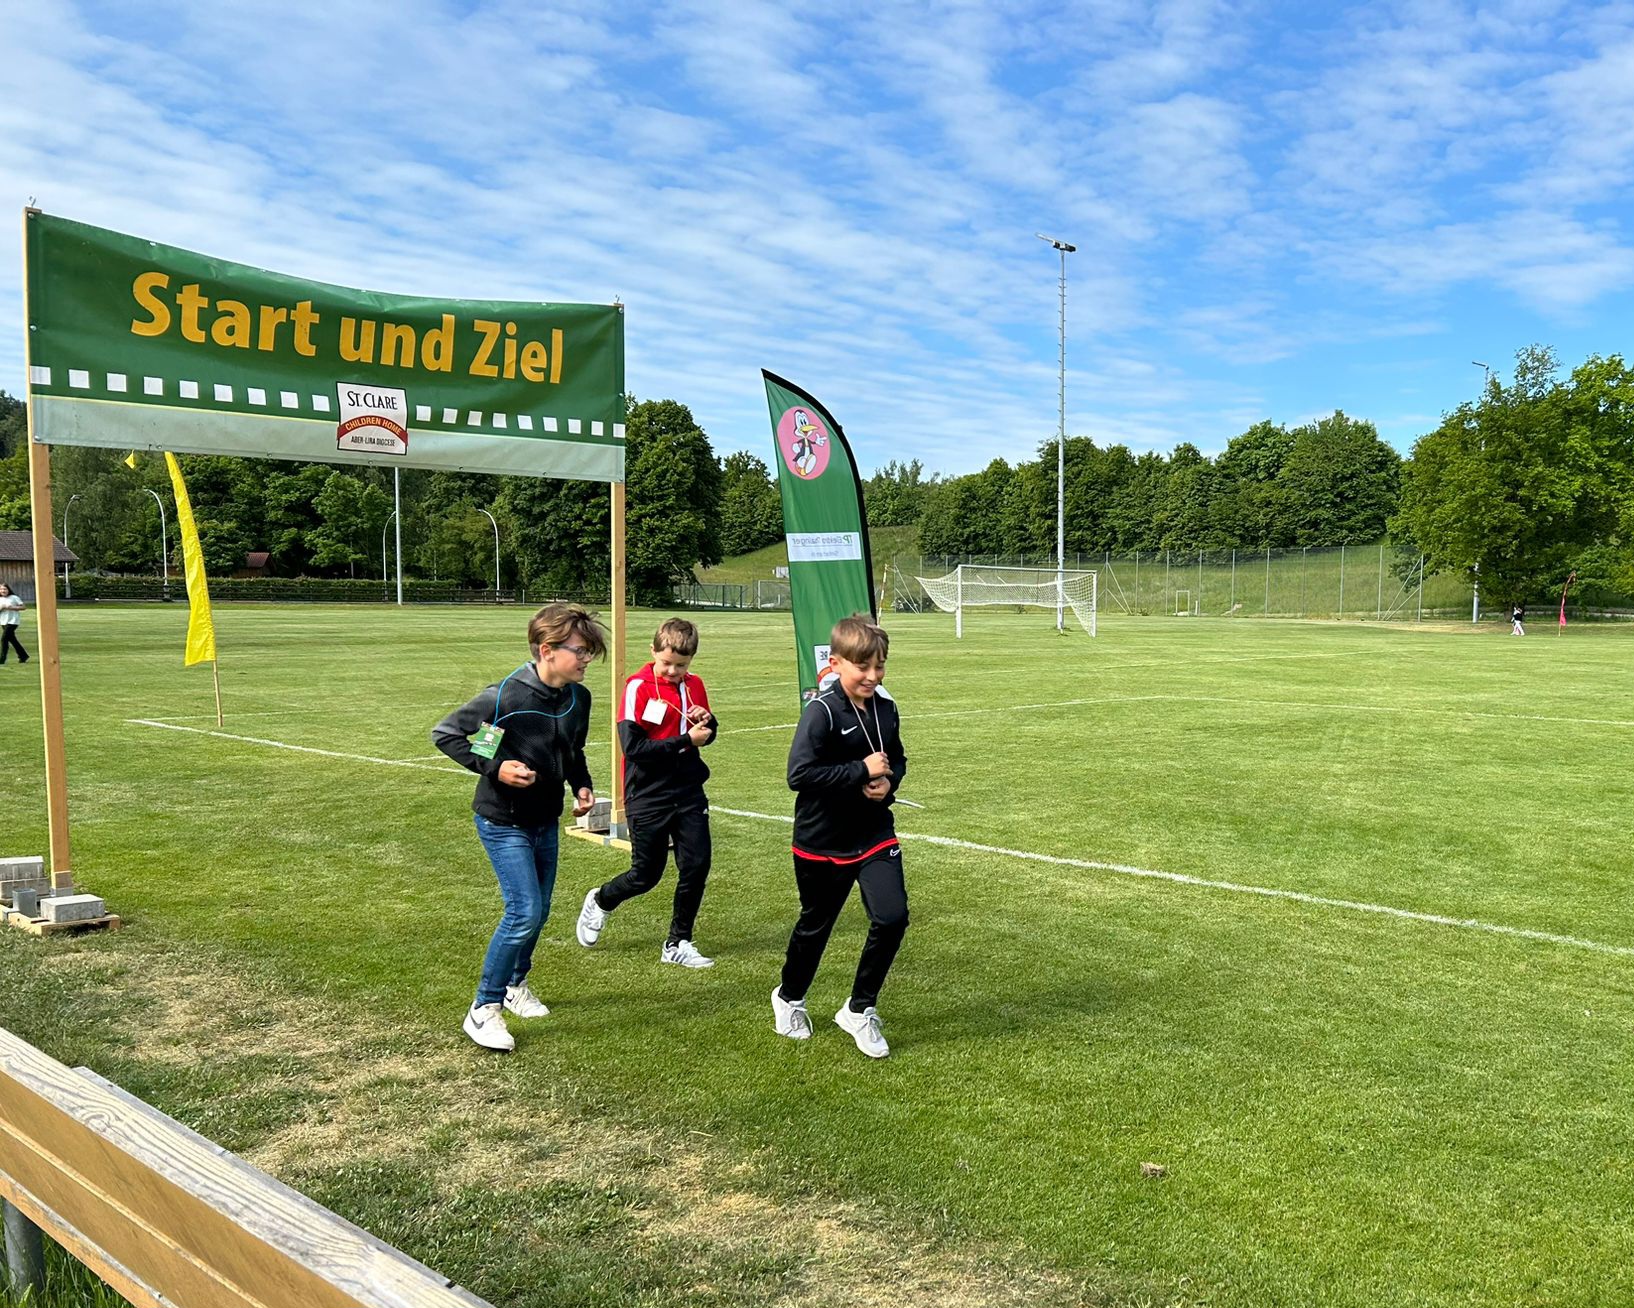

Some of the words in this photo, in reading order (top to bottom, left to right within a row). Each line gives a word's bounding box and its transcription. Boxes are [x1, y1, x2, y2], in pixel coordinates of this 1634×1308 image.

[131, 271, 320, 357] Start
[338, 313, 455, 373] und
[469, 319, 563, 384] Ziel
[363, 392, 398, 410] CLARE
[345, 417, 382, 431] CHILDREN
[382, 419, 402, 436] HOME
[376, 437, 396, 447] DIOCESE
